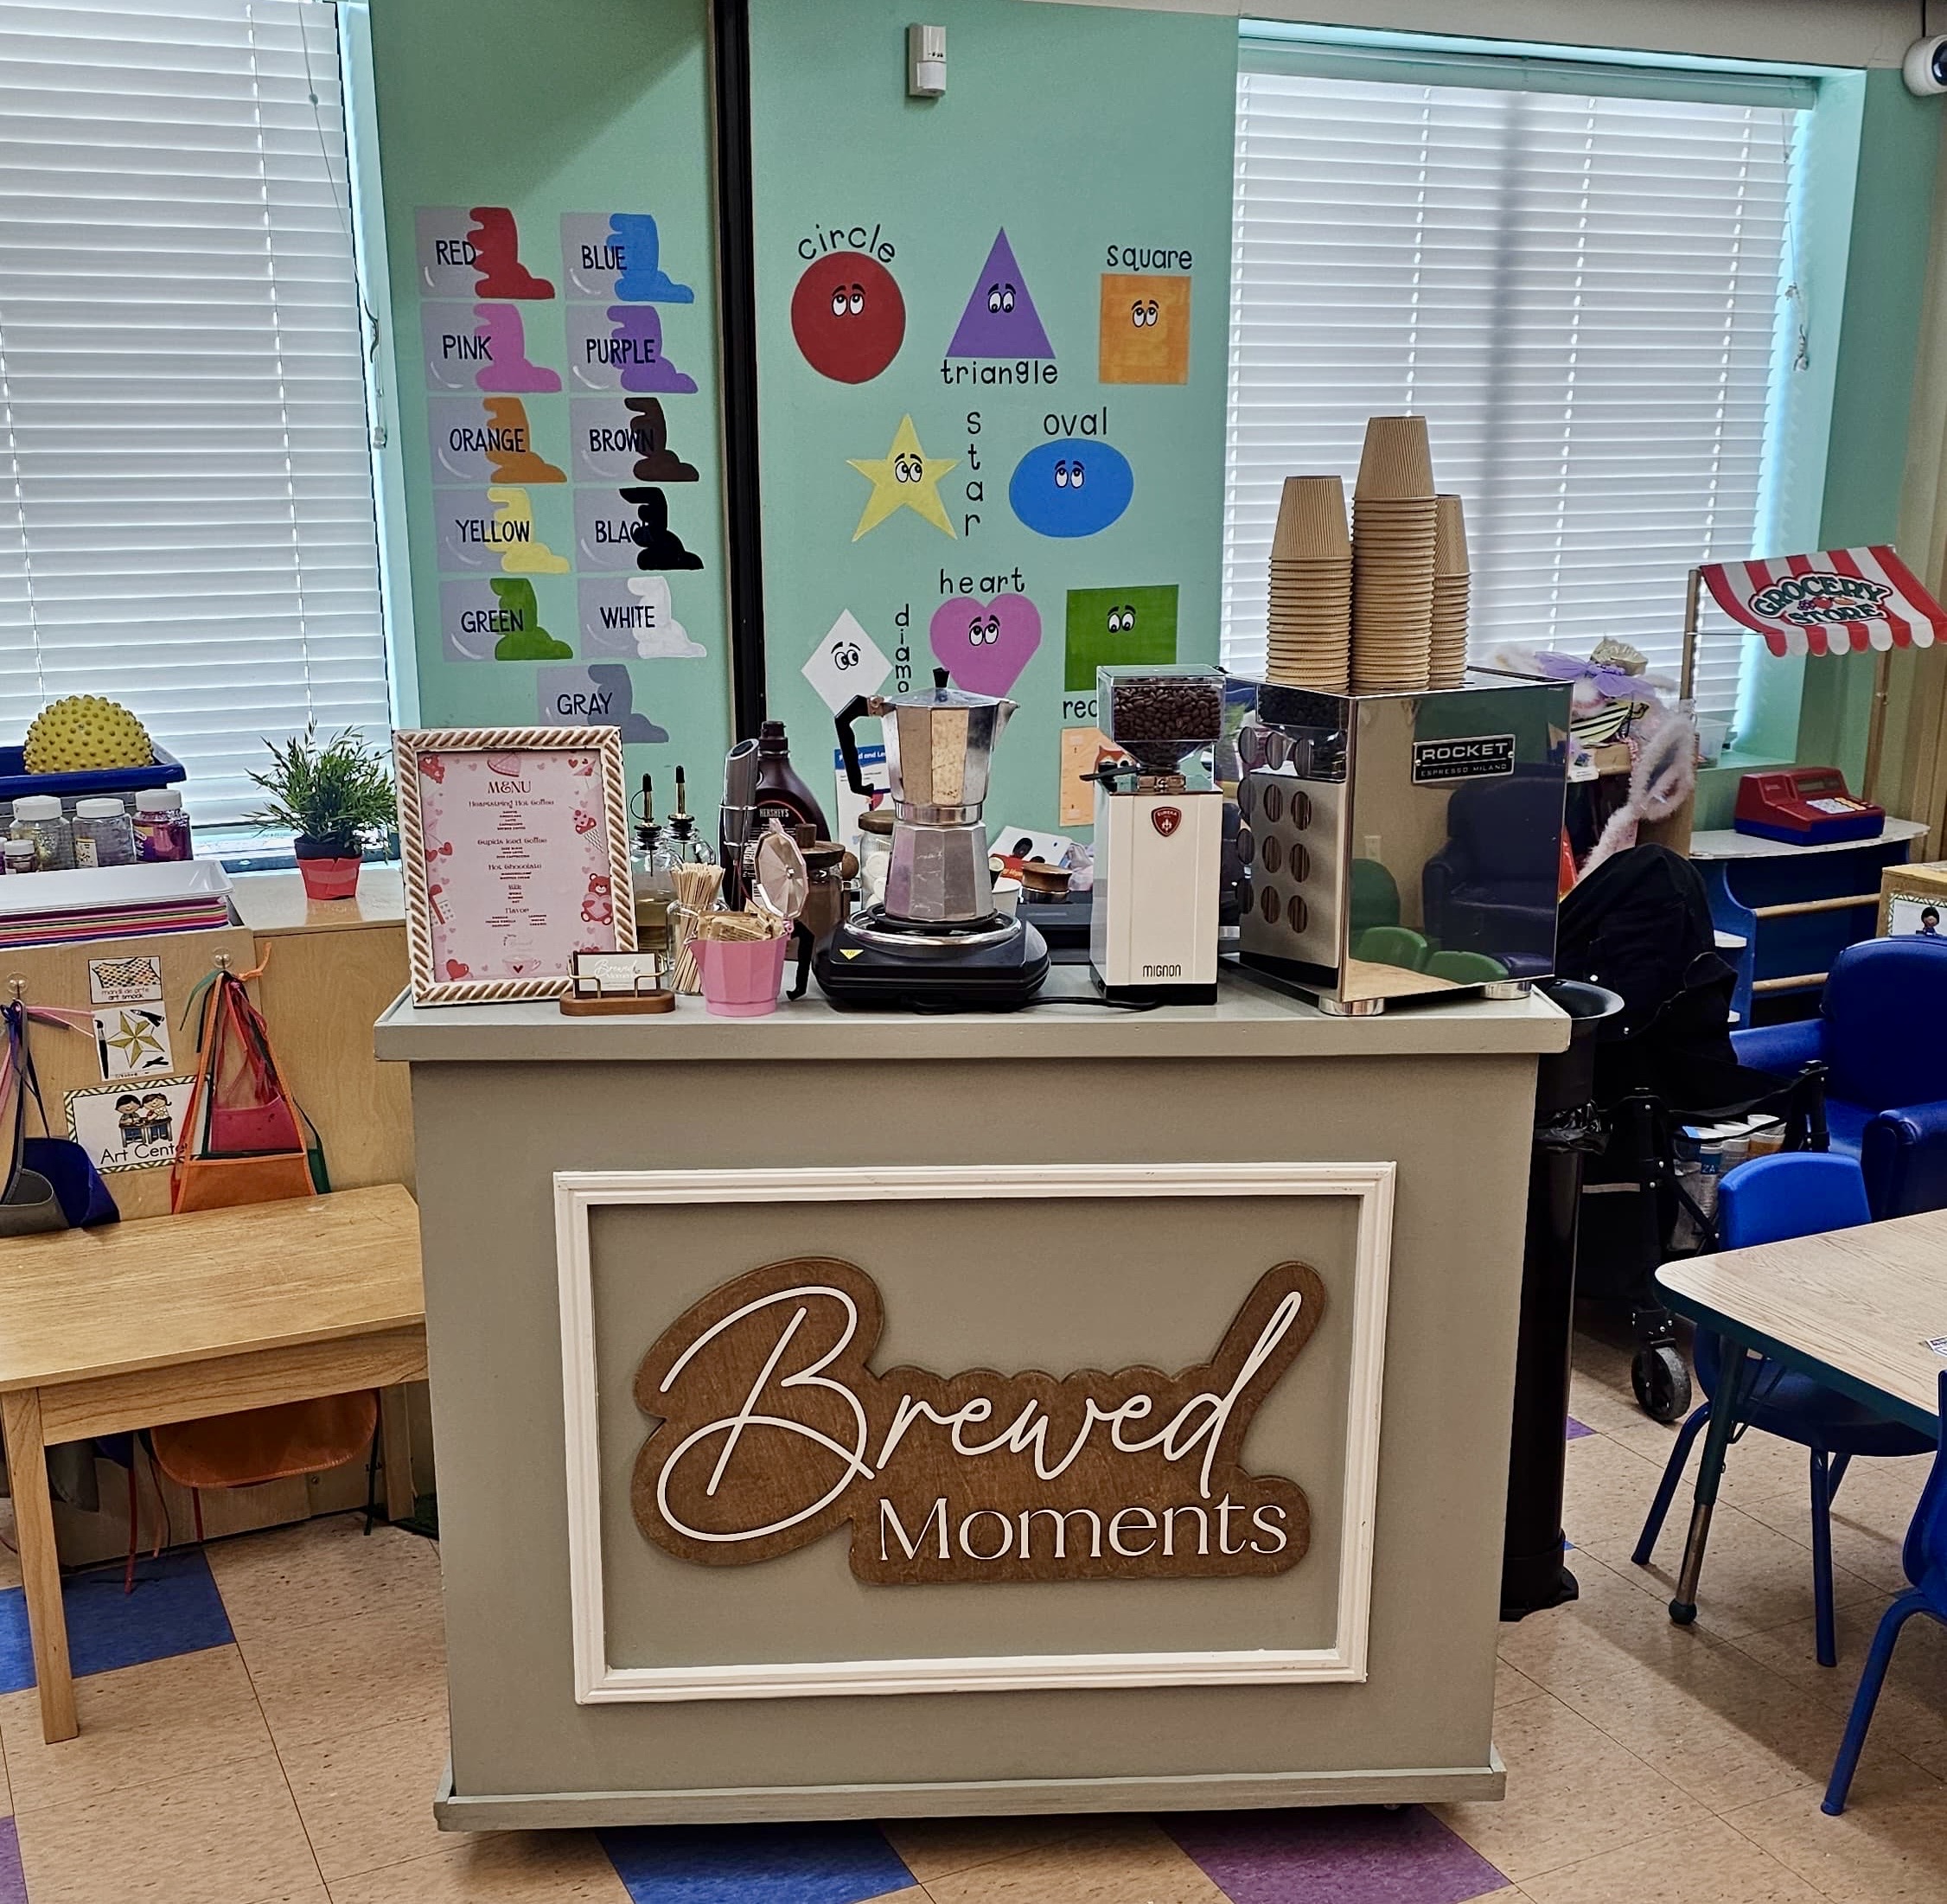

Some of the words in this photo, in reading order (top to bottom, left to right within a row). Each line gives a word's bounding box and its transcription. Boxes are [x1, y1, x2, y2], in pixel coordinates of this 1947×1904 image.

[435, 240, 476, 265] RED
[797, 223, 896, 263] circle
[582, 245, 627, 271] BLUE
[1107, 245, 1192, 271] square
[442, 335, 492, 361] PINK
[586, 338, 655, 365] PURPLE
[941, 360, 1058, 384] triangle
[1043, 406, 1108, 437] oval
[450, 428, 527, 453] ORANGE
[590, 428, 654, 452] BROWN
[965, 412, 984, 537] star
[455, 520, 531, 544] YELLOW
[941, 569, 1025, 594] heart
[1754, 576, 1887, 615] GROCERY
[461, 608, 524, 633] GREEN
[600, 605, 655, 629] WHITE
[1788, 604, 1884, 624] STORE
[894, 604, 911, 693] diamo
[558, 693, 613, 716] GRAY
[1063, 699, 1098, 719] rec
[1422, 743, 1508, 760] ROCKET
[1420, 767, 1468, 777] ESPRESSO
[100, 1148, 128, 1165] Art
[655, 1284, 1303, 1543] Brewed
[878, 1492, 1287, 1562] Moments
